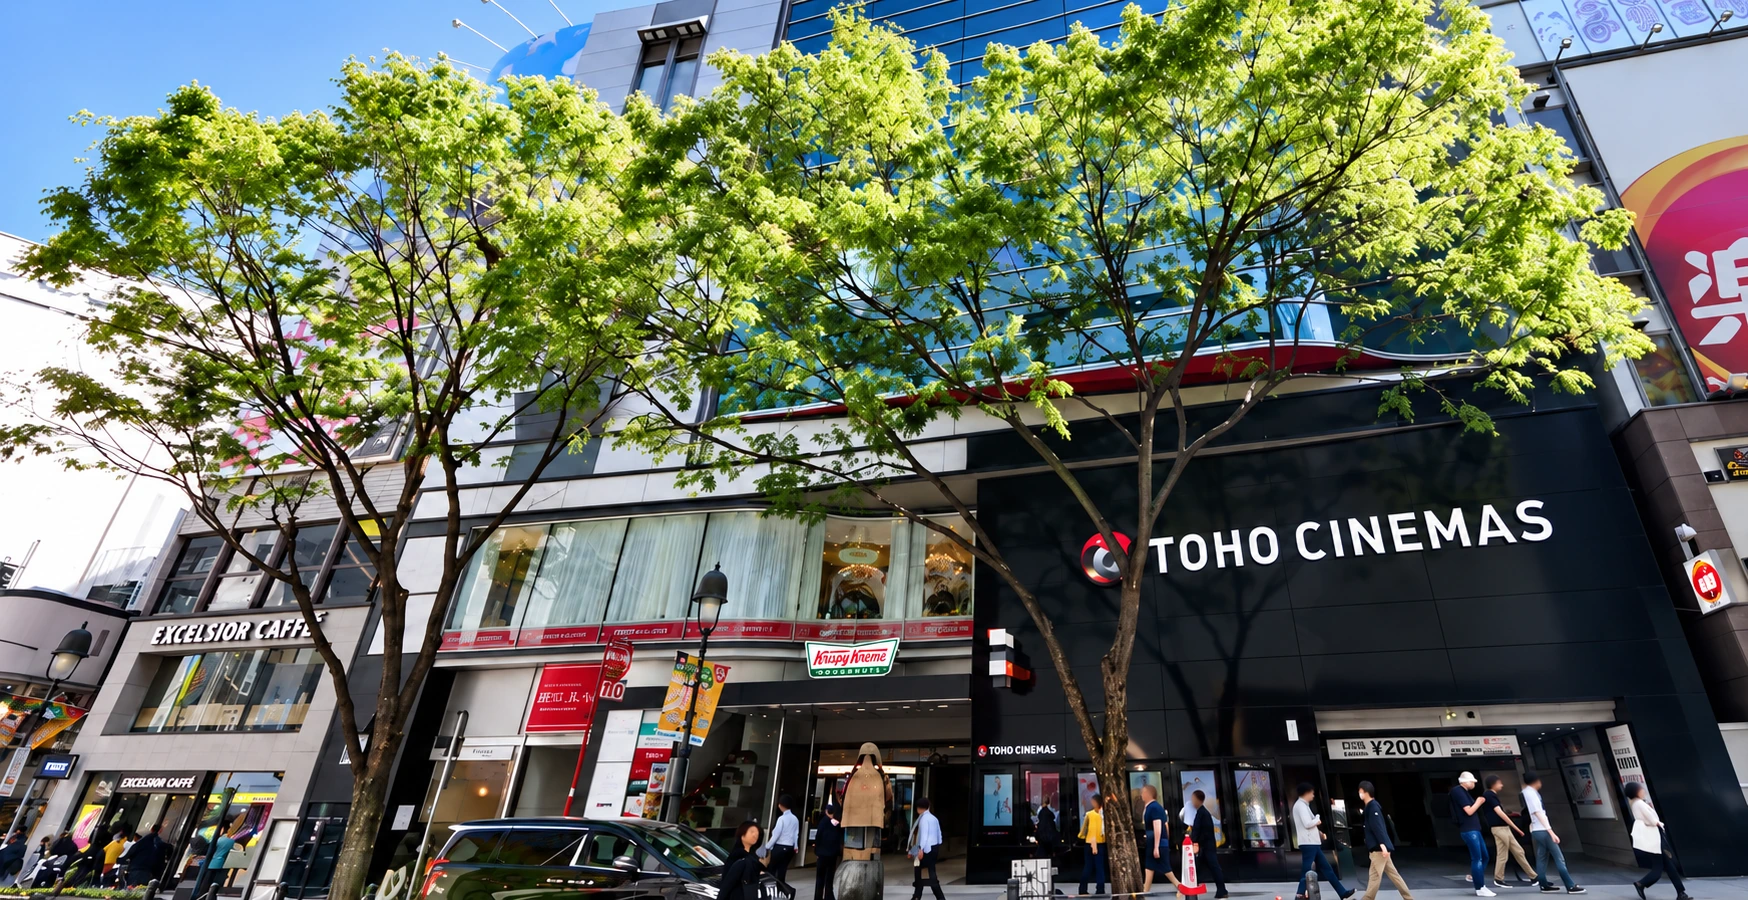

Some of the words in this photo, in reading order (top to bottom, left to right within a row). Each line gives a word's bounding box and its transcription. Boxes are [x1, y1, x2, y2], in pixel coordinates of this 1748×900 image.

[1149, 525, 1279, 574] TOHO
[1295, 499, 1554, 562] CINEMAS
[150, 621, 250, 646] EXCELSIOR
[813, 650, 850, 666] Krispy
[850, 648, 888, 664] Kreme
[988, 746, 1014, 755] TOHO
[1015, 745, 1057, 754] CINEMAS
[1370, 739, 1435, 756] ¥2000
[120, 777, 167, 788] EXCELSIOR
[166, 775, 197, 788] CAFFÉ
